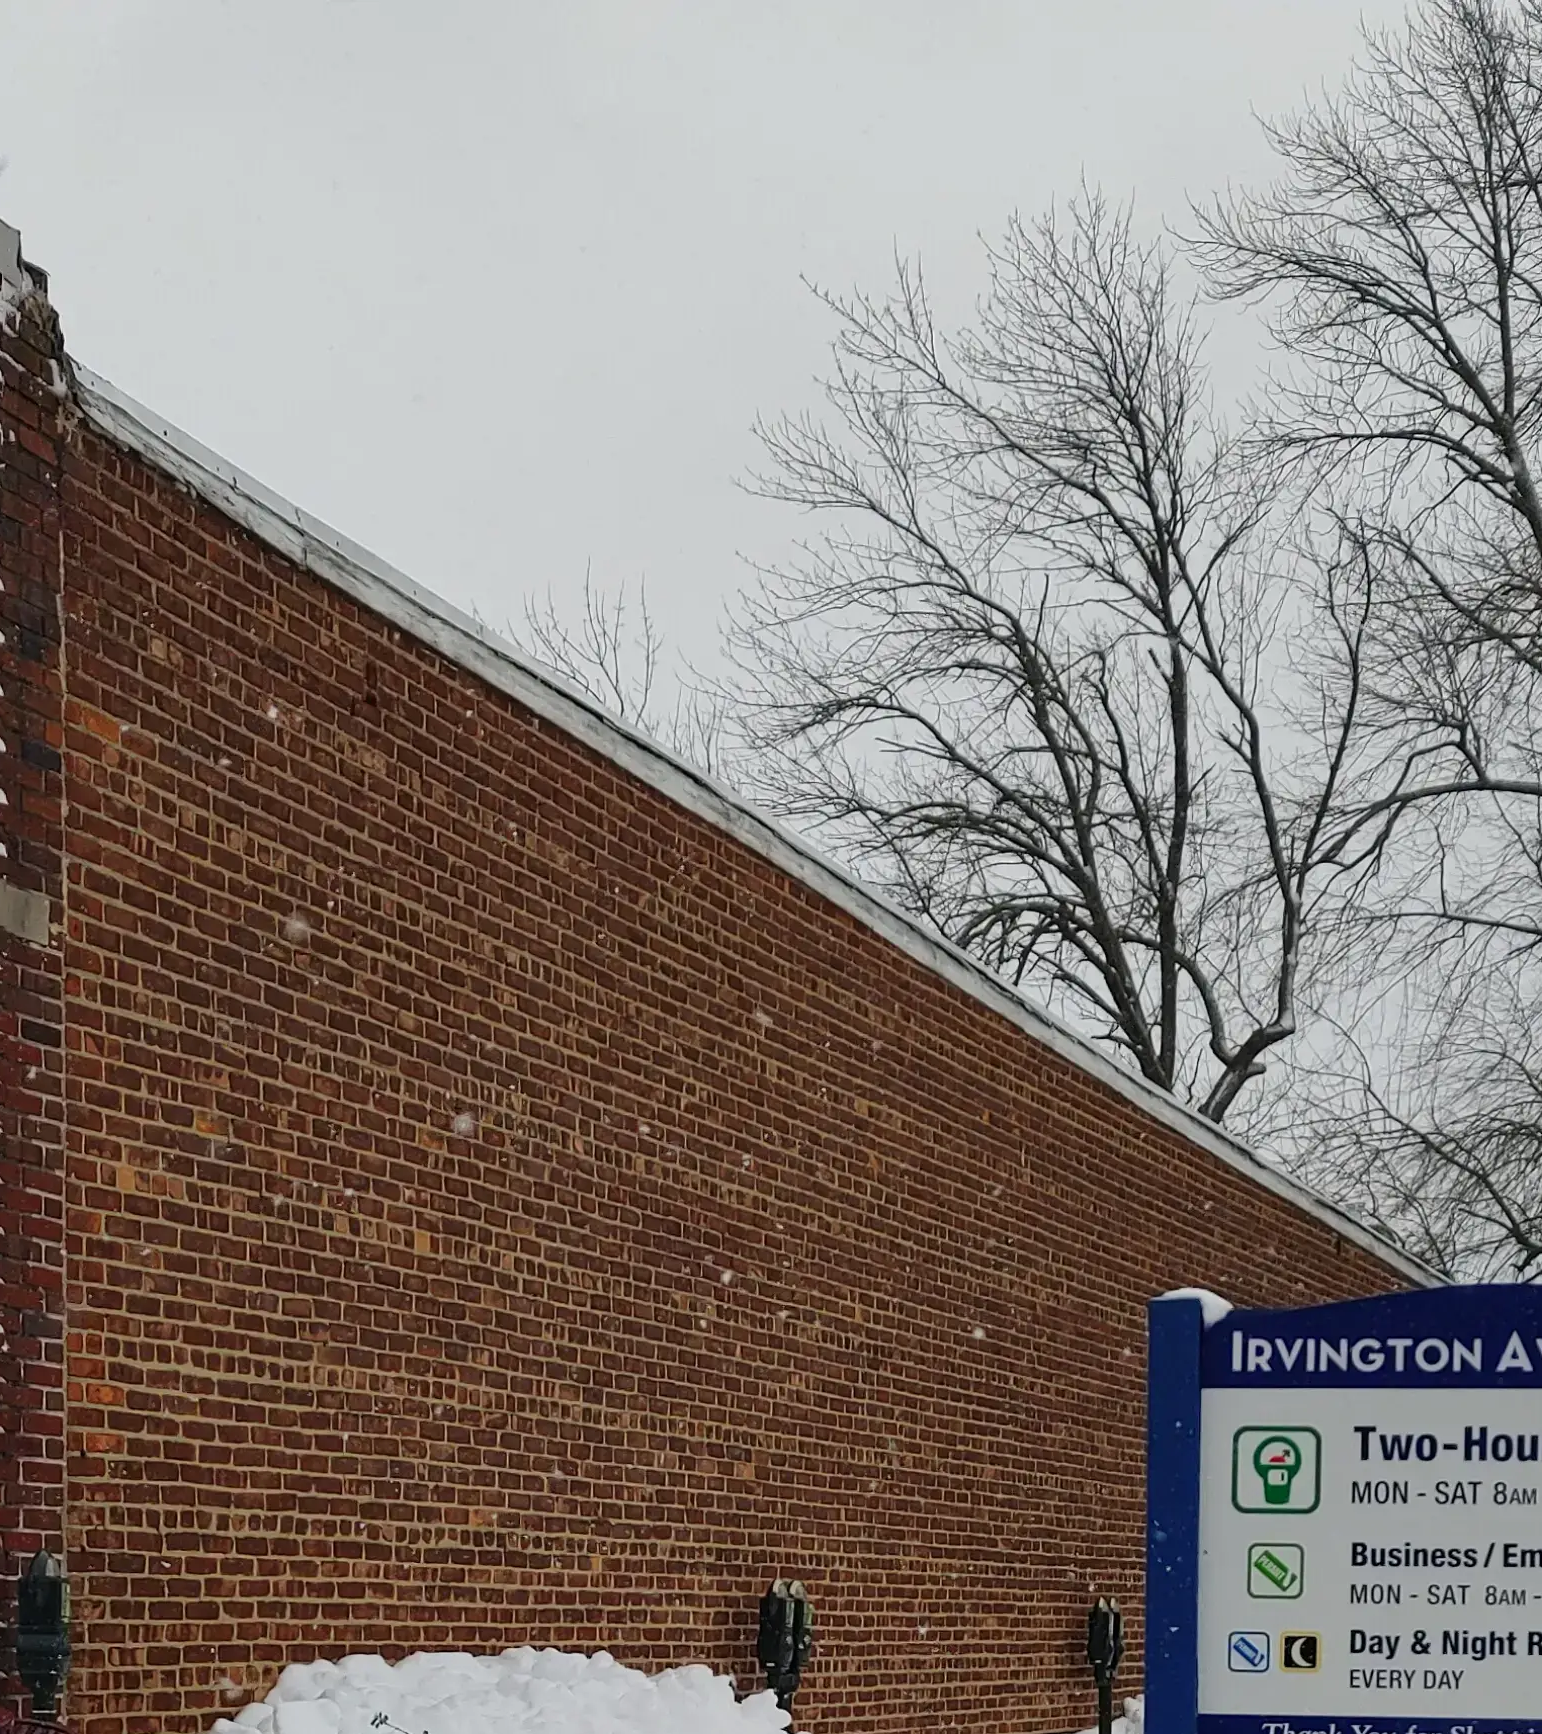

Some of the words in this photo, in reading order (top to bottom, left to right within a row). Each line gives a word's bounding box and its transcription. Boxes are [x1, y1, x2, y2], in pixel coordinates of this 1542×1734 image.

[1232, 1330, 1482, 1373] IRVINGTON
[1351, 1480, 1408, 1504] MON
[1434, 1481, 1483, 1505] SAT
[1493, 1481, 1537, 1505] 8AM
[1351, 1542, 1478, 1568] Business
[1350, 1584, 1401, 1604] MON
[1427, 1584, 1471, 1605] SAT
[1484, 1585, 1526, 1606] 8AM
[1350, 1629, 1400, 1660] Day
[1410, 1630, 1432, 1655] &
[1442, 1630, 1517, 1661] Night
[1350, 1669, 1416, 1689] EVERY
[1423, 1670, 1464, 1690] DAY
